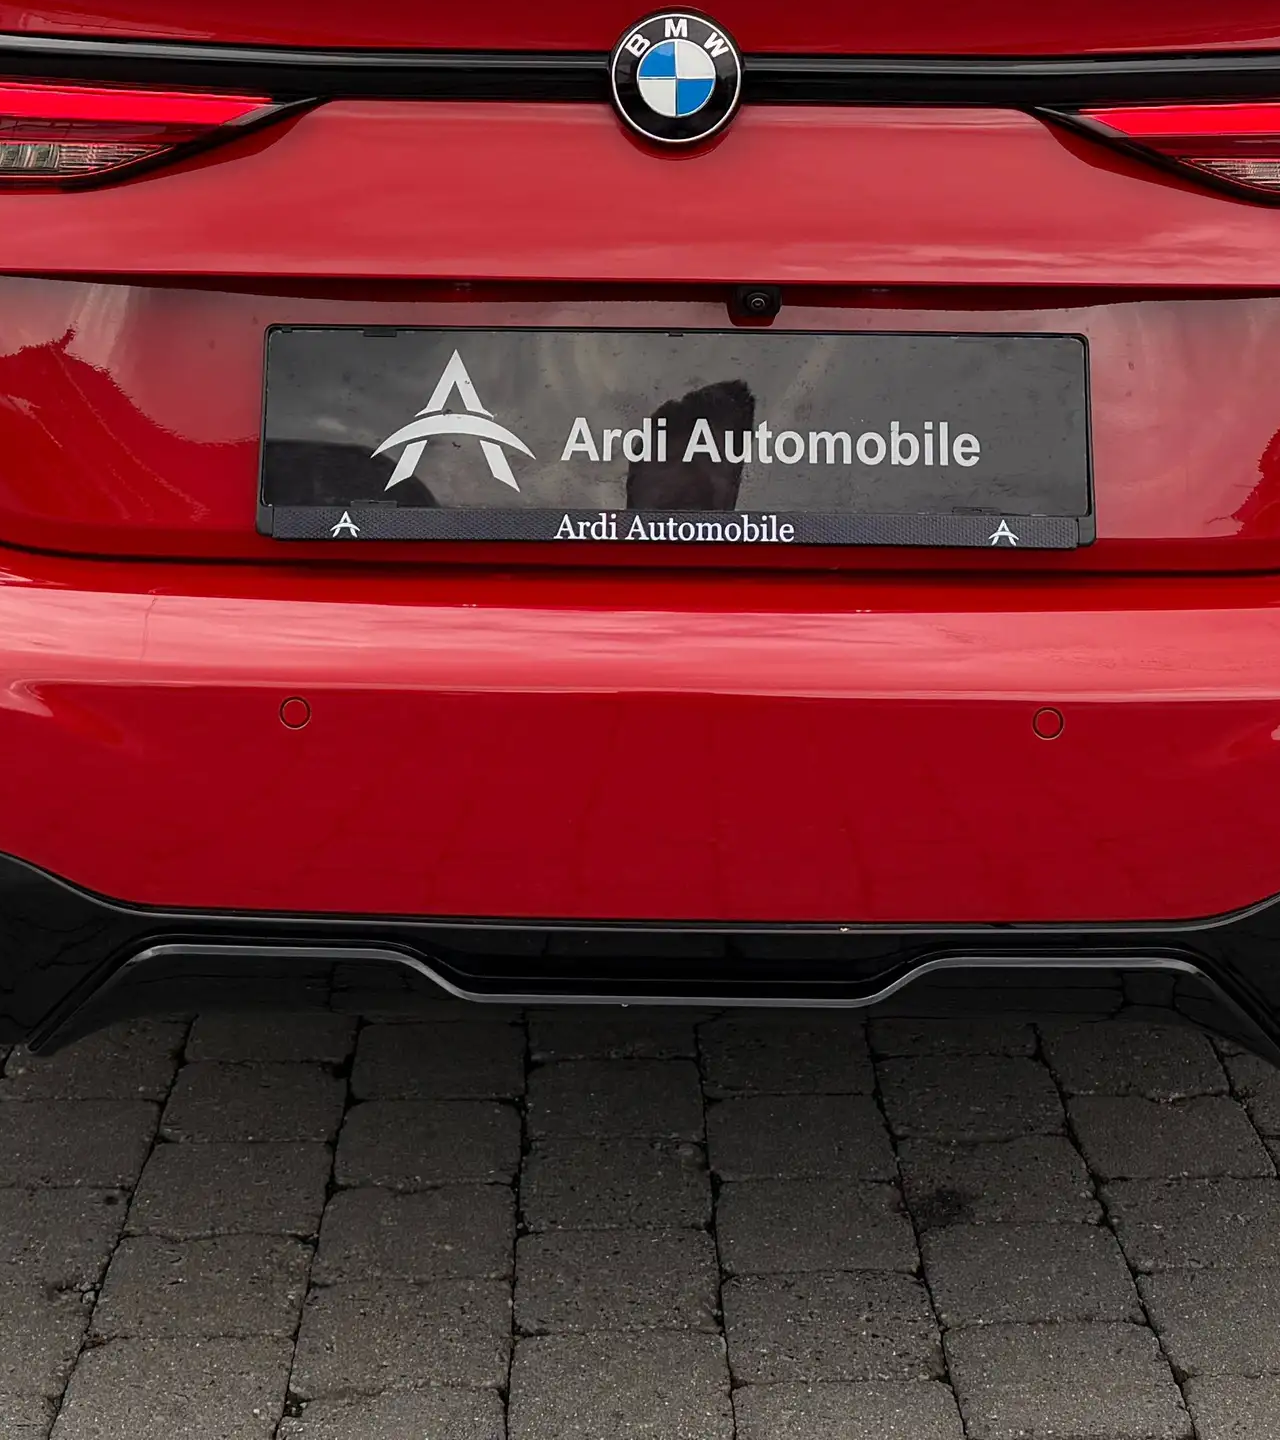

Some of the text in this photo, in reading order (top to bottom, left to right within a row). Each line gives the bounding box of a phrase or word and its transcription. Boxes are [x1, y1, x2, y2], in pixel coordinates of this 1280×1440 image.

[624, 18, 729, 58] BMW
[560, 417, 981, 467] Ardi Automobile
[553, 513, 795, 544] Ardi Automobile
